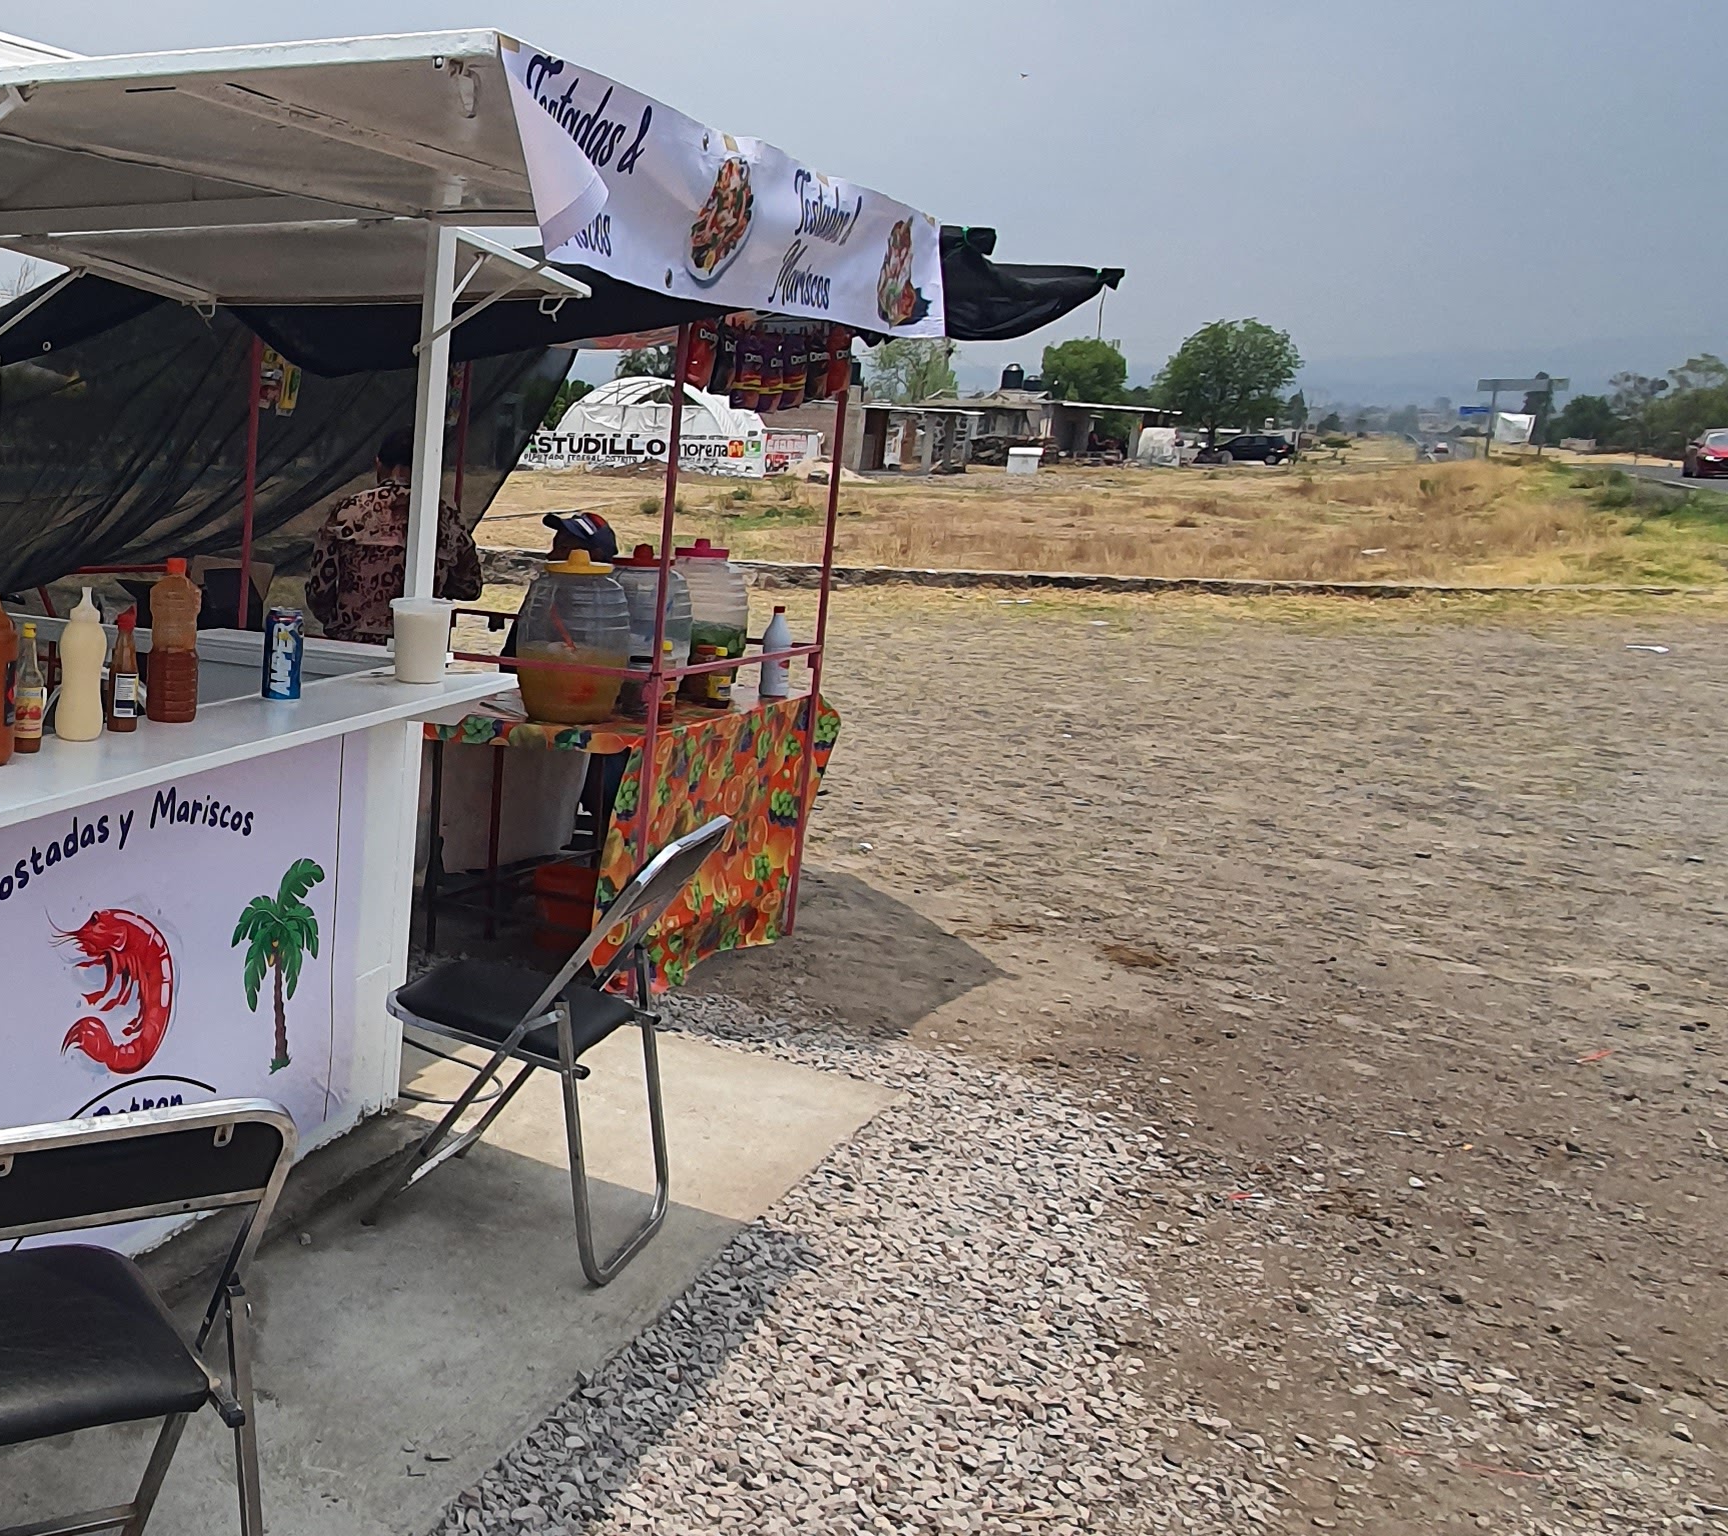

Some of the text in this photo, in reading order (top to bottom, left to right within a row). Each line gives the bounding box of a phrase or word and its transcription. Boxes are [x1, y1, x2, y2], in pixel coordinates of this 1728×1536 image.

[616, 105, 653, 174] &
[794, 169, 851, 243] Tostadas
[768, 239, 831, 310] Mariscos
[119, 809, 135, 851] y
[149, 786, 255, 837] Mariscos
